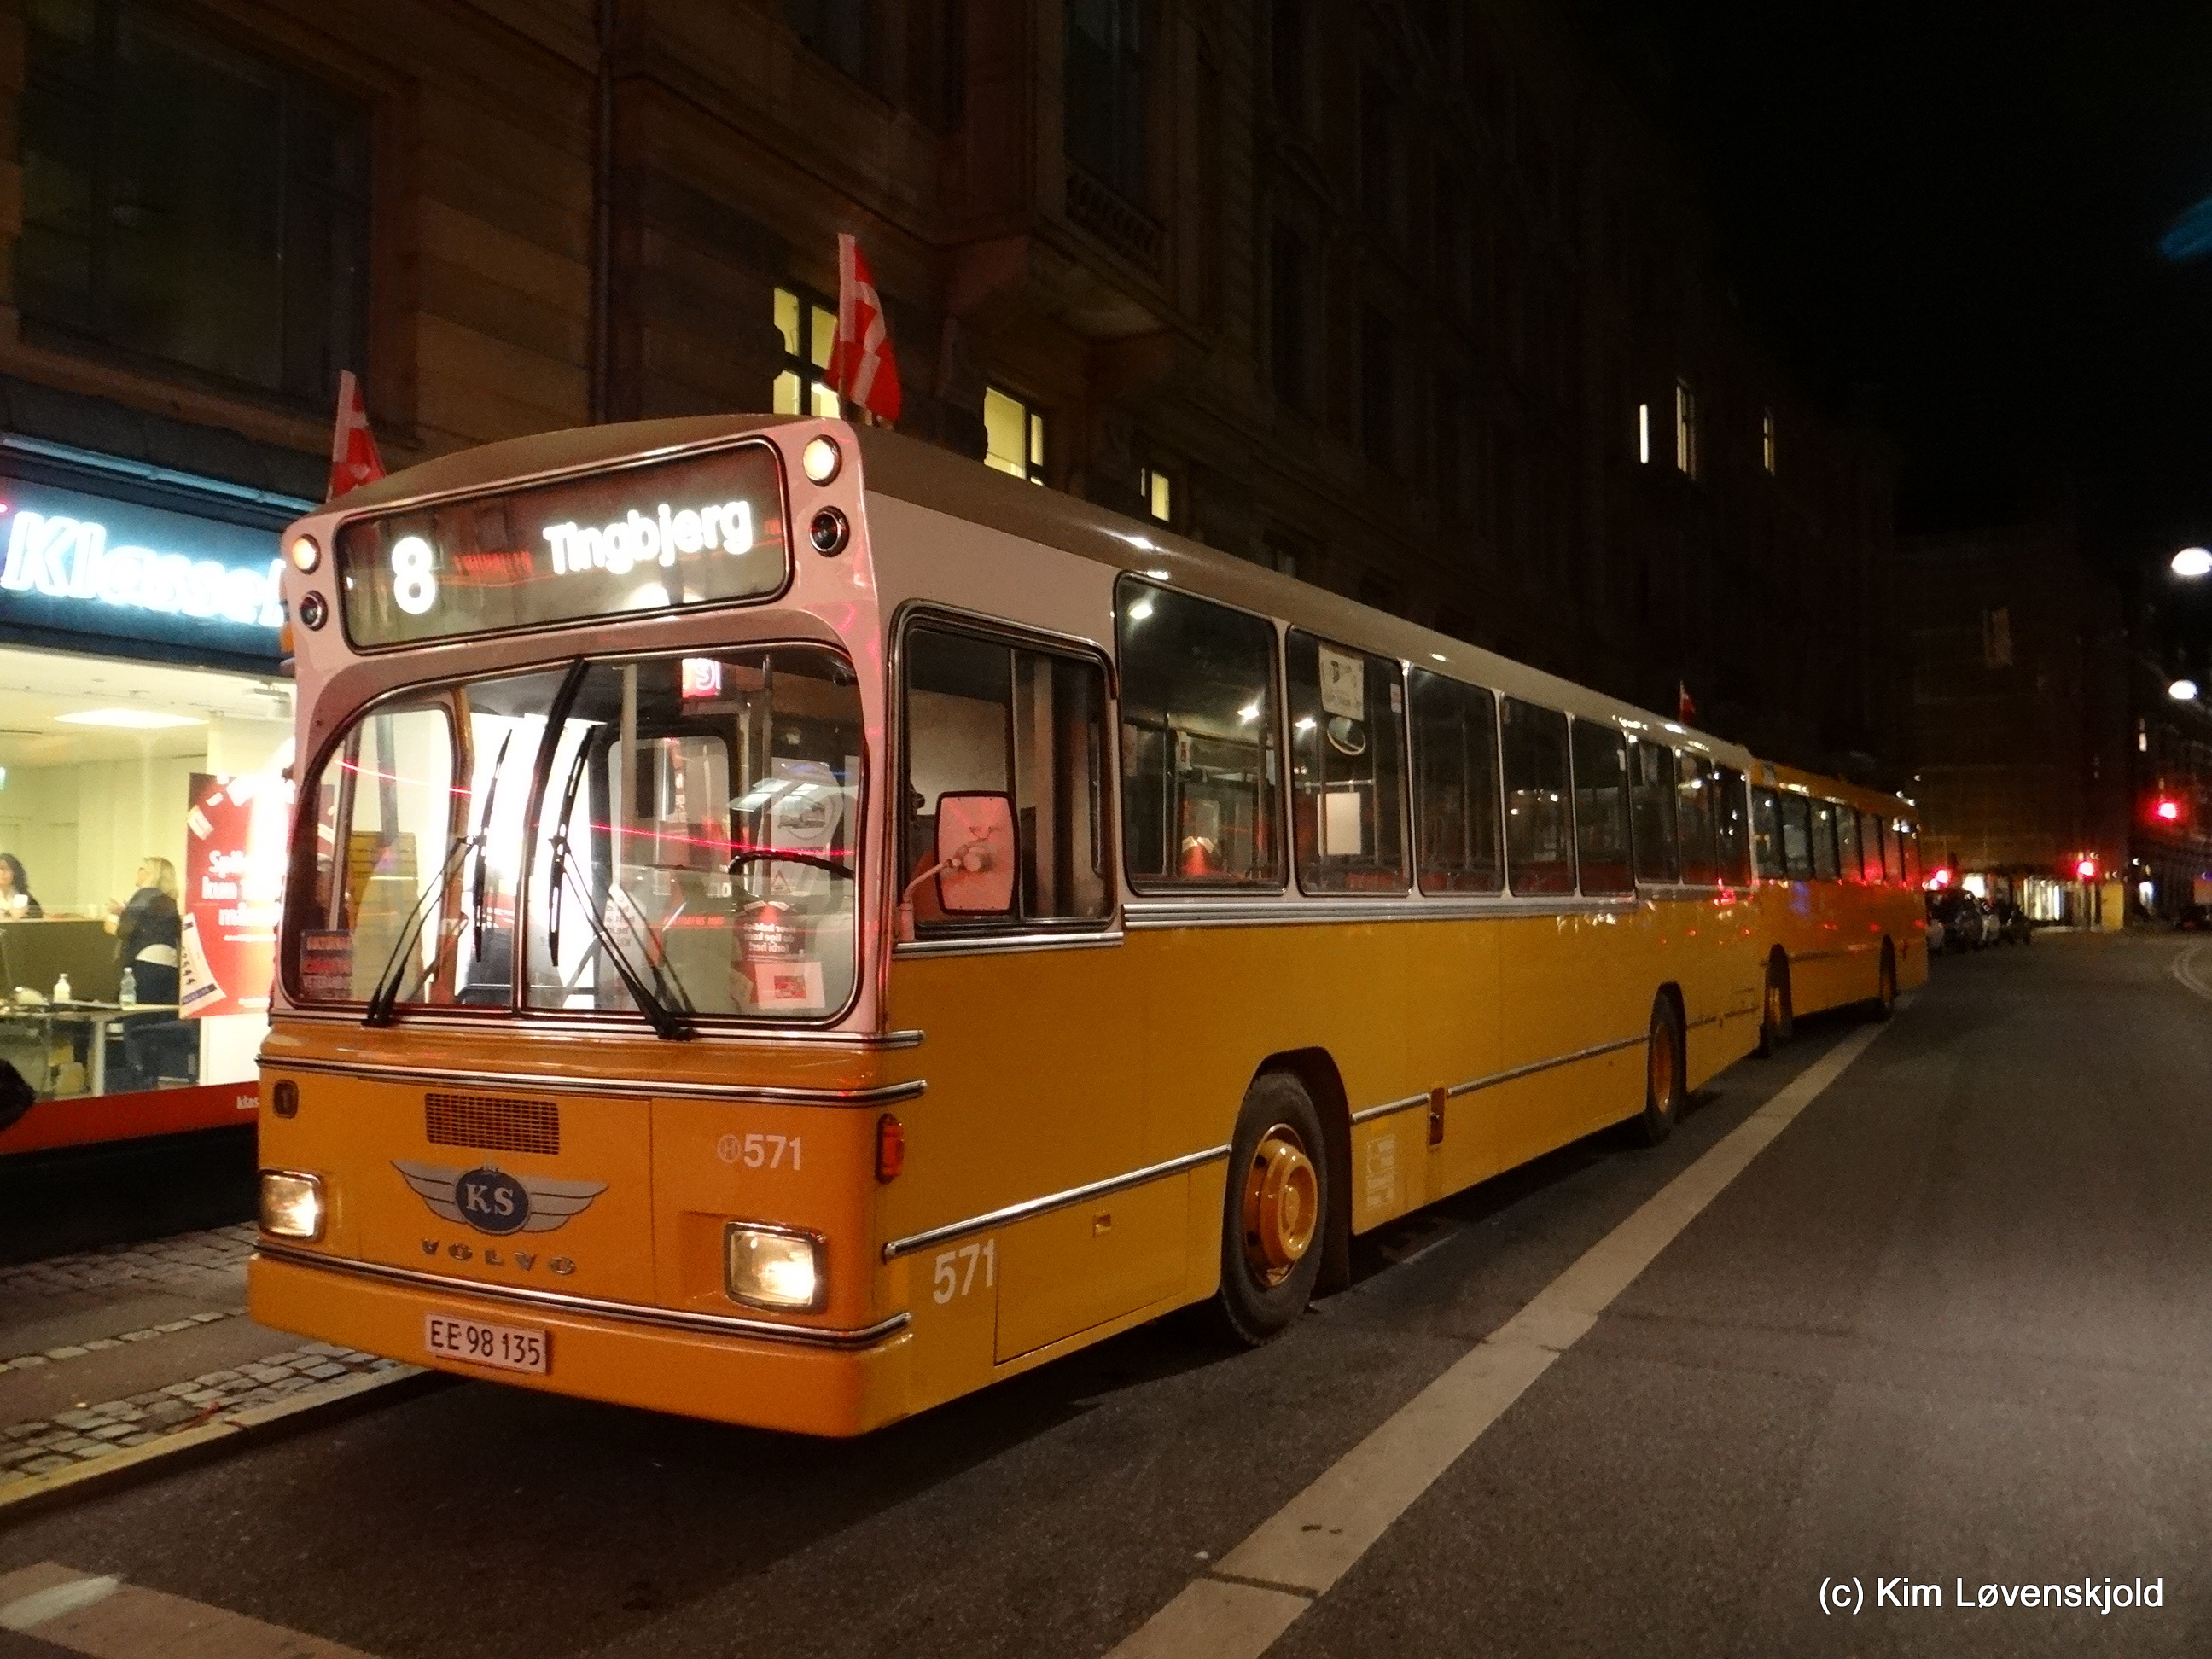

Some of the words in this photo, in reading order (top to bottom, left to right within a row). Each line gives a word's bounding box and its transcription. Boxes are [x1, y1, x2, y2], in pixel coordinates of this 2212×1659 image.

[392, 537, 439, 614] 8
[543, 501, 754, 575] Tingbjerg
[744, 1133, 800, 1170] 571
[466, 1183, 515, 1216] KS
[421, 1238, 576, 1276] VOLVO
[934, 1238, 994, 1304] 571
